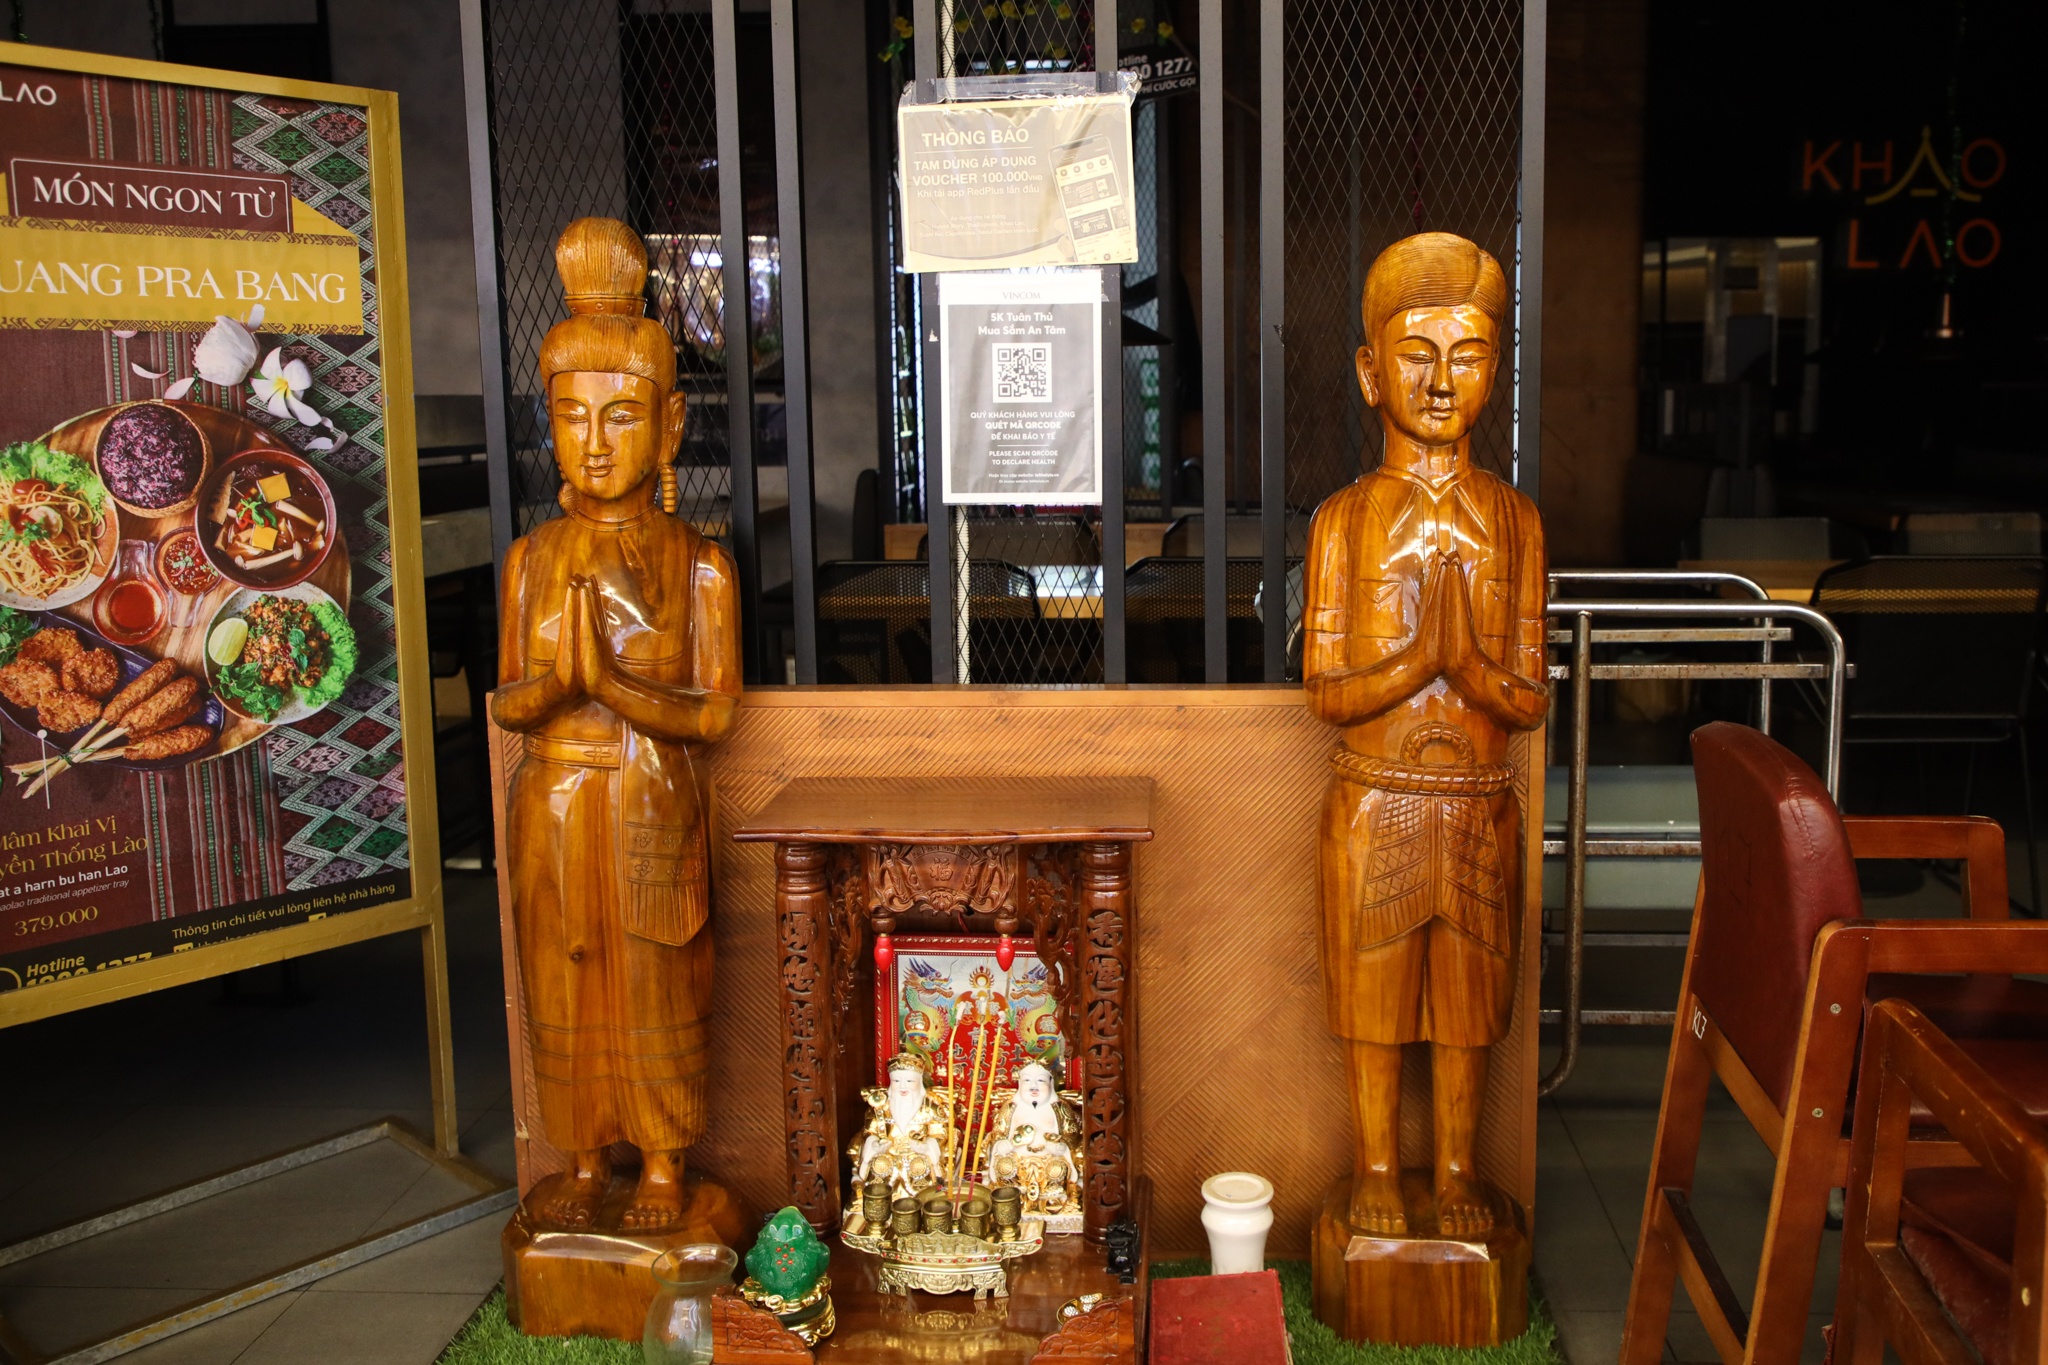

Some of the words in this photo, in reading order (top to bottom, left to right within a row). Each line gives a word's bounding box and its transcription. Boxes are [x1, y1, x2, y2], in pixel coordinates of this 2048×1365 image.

[1118, 55, 1148, 67] otline
[1155, 57, 1193, 77] 1277
[921, 128, 986, 148] THÔNG
[991, 125, 1029, 144] BÁO
[913, 161, 940, 173] TẠM
[943, 157, 979, 170] DỪNG
[982, 155, 998, 168] ÁP
[1001, 156, 1037, 169] DỤNG
[1802, 124, 2007, 206] KHAO
[913, 173, 978, 187] VOUCHER
[33, 172, 115, 207] MÓN
[125, 183, 223, 216] NGON
[230, 190, 276, 218] TỪ
[917, 189, 932, 198] Khi
[934, 188, 945, 197] tải
[947, 189, 965, 198] app
[967, 187, 1004, 196] RedPlus
[1847, 217, 2002, 270] LAO
[136, 265, 225, 300] PRA
[236, 270, 346, 303] BANG
[1002, 291, 1041, 300] VINCOM
[990, 312, 1004, 322] 5K
[1006, 312, 1031, 322] Tuân
[1034, 311, 1053, 322] Thủ
[978, 326, 1001, 335] Mua
[1002, 324, 1025, 335] Sắm
[1027, 326, 1042, 335] An
[1044, 325, 1066, 335] Tâm
[970, 411, 987, 419] QUÝ
[988, 410, 1015, 419] KHÁCH
[1016, 410, 1038, 418] HÀNG
[1054, 409, 1075, 418] LÒNG
[985, 420, 1008, 430] QUÉT
[1010, 420, 1023, 429] MÃ
[1024, 421, 1061, 430] QRCODE
[1022, 432, 1038, 440] BÁO
[1031, 449, 1058, 457] QRCODE
[47, 820, 90, 843] Khai
[95, 815, 116, 834] Vị
[40, 842, 107, 869] Thống
[112, 836, 148, 856] Lào
[13, 885, 22, 895] a
[25, 879, 56, 893] harn
[59, 875, 75, 887] bu
[78, 870, 102, 882] han
[105, 865, 128, 877] Lao
[0, 901, 25, 912] aolao
[26, 889, 71, 907] traditional
[71, 883, 112, 898] appetizer
[112, 879, 130, 890] tray
[15, 905, 98, 937] 379.000
[171, 923, 210, 940] Thông
[211, 919, 227, 931] tin
[229, 914, 246, 926] chi
[248, 907, 267, 922] tiết
[268, 905, 285, 917] vui
[286, 901, 311, 917] lòng
[312, 896, 332, 909] liên
[334, 893, 347, 905] hệ
[349, 887, 368, 901] nhà
[370, 883, 396, 898] hàng
[26, 954, 86, 978] Hotline
